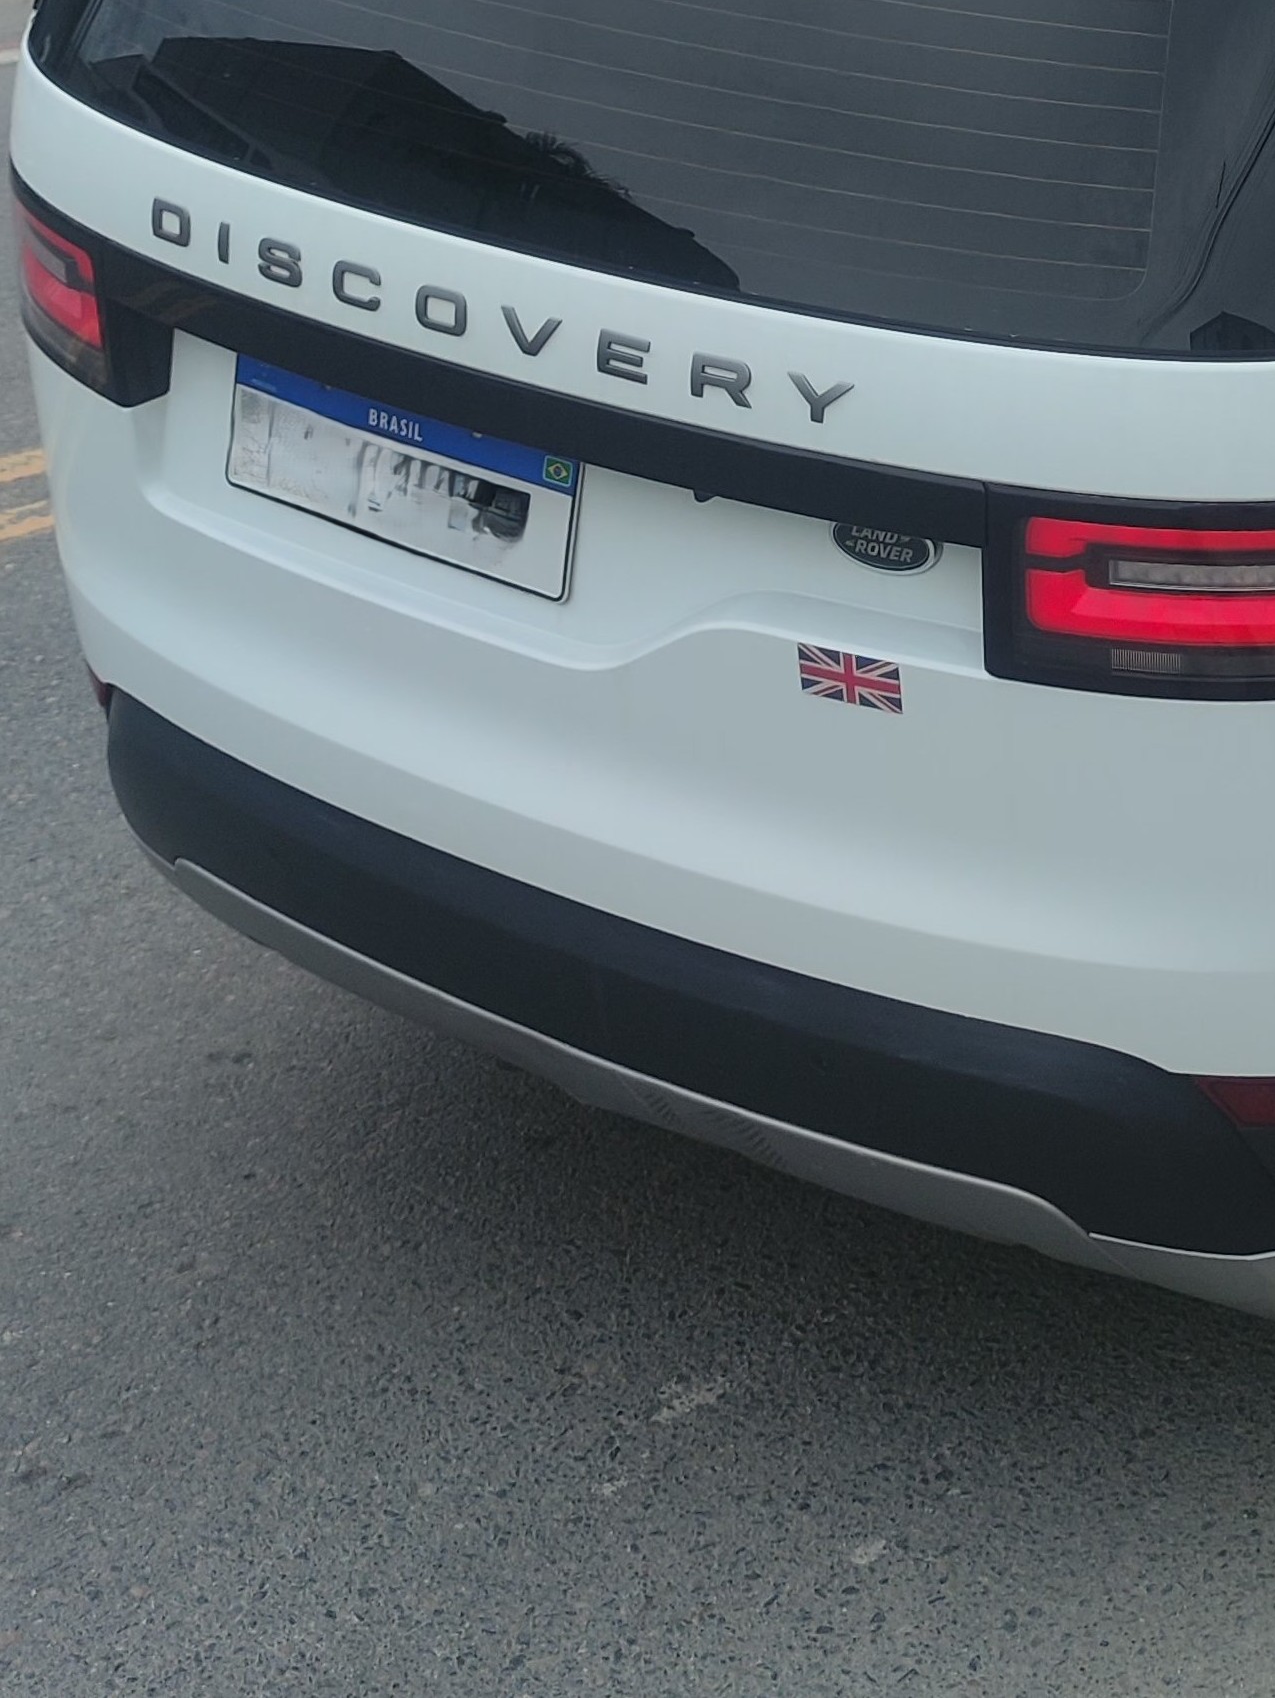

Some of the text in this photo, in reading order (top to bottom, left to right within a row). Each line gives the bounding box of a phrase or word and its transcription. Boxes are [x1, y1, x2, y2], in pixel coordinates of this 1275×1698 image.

[152, 197, 856, 424] DISCOVERY
[368, 407, 423, 443] BRASIL
[851, 525, 899, 544] LAND
[854, 538, 914, 563] ROVER
